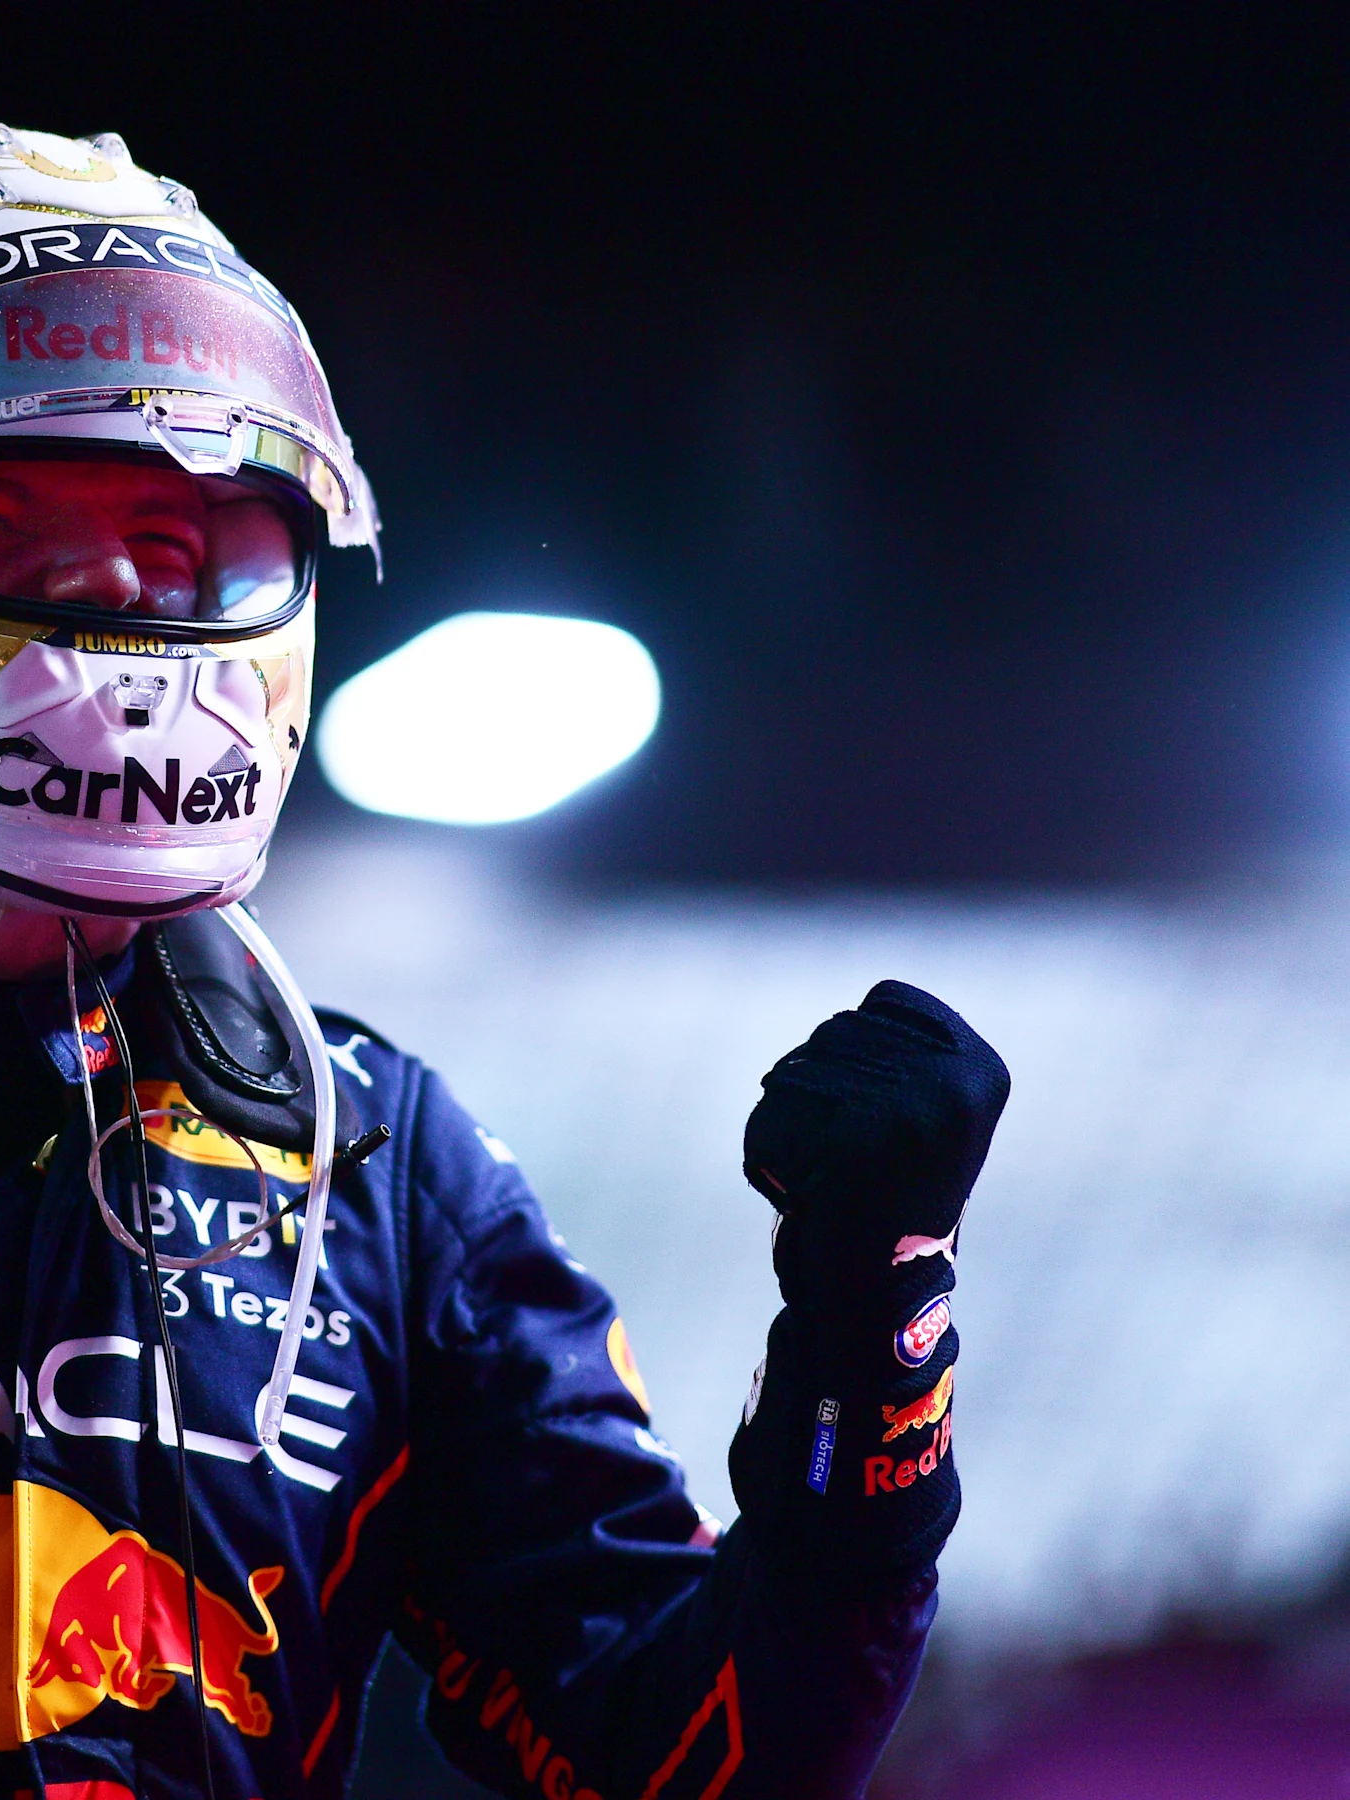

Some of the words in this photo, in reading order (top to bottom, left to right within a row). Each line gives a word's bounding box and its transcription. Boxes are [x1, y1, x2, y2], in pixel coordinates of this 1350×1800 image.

[4, 303, 130, 362] Red
[141, 310, 237, 381] Bull
[200, 1270, 352, 1346] Tezos
[864, 1426, 940, 1497] Red
